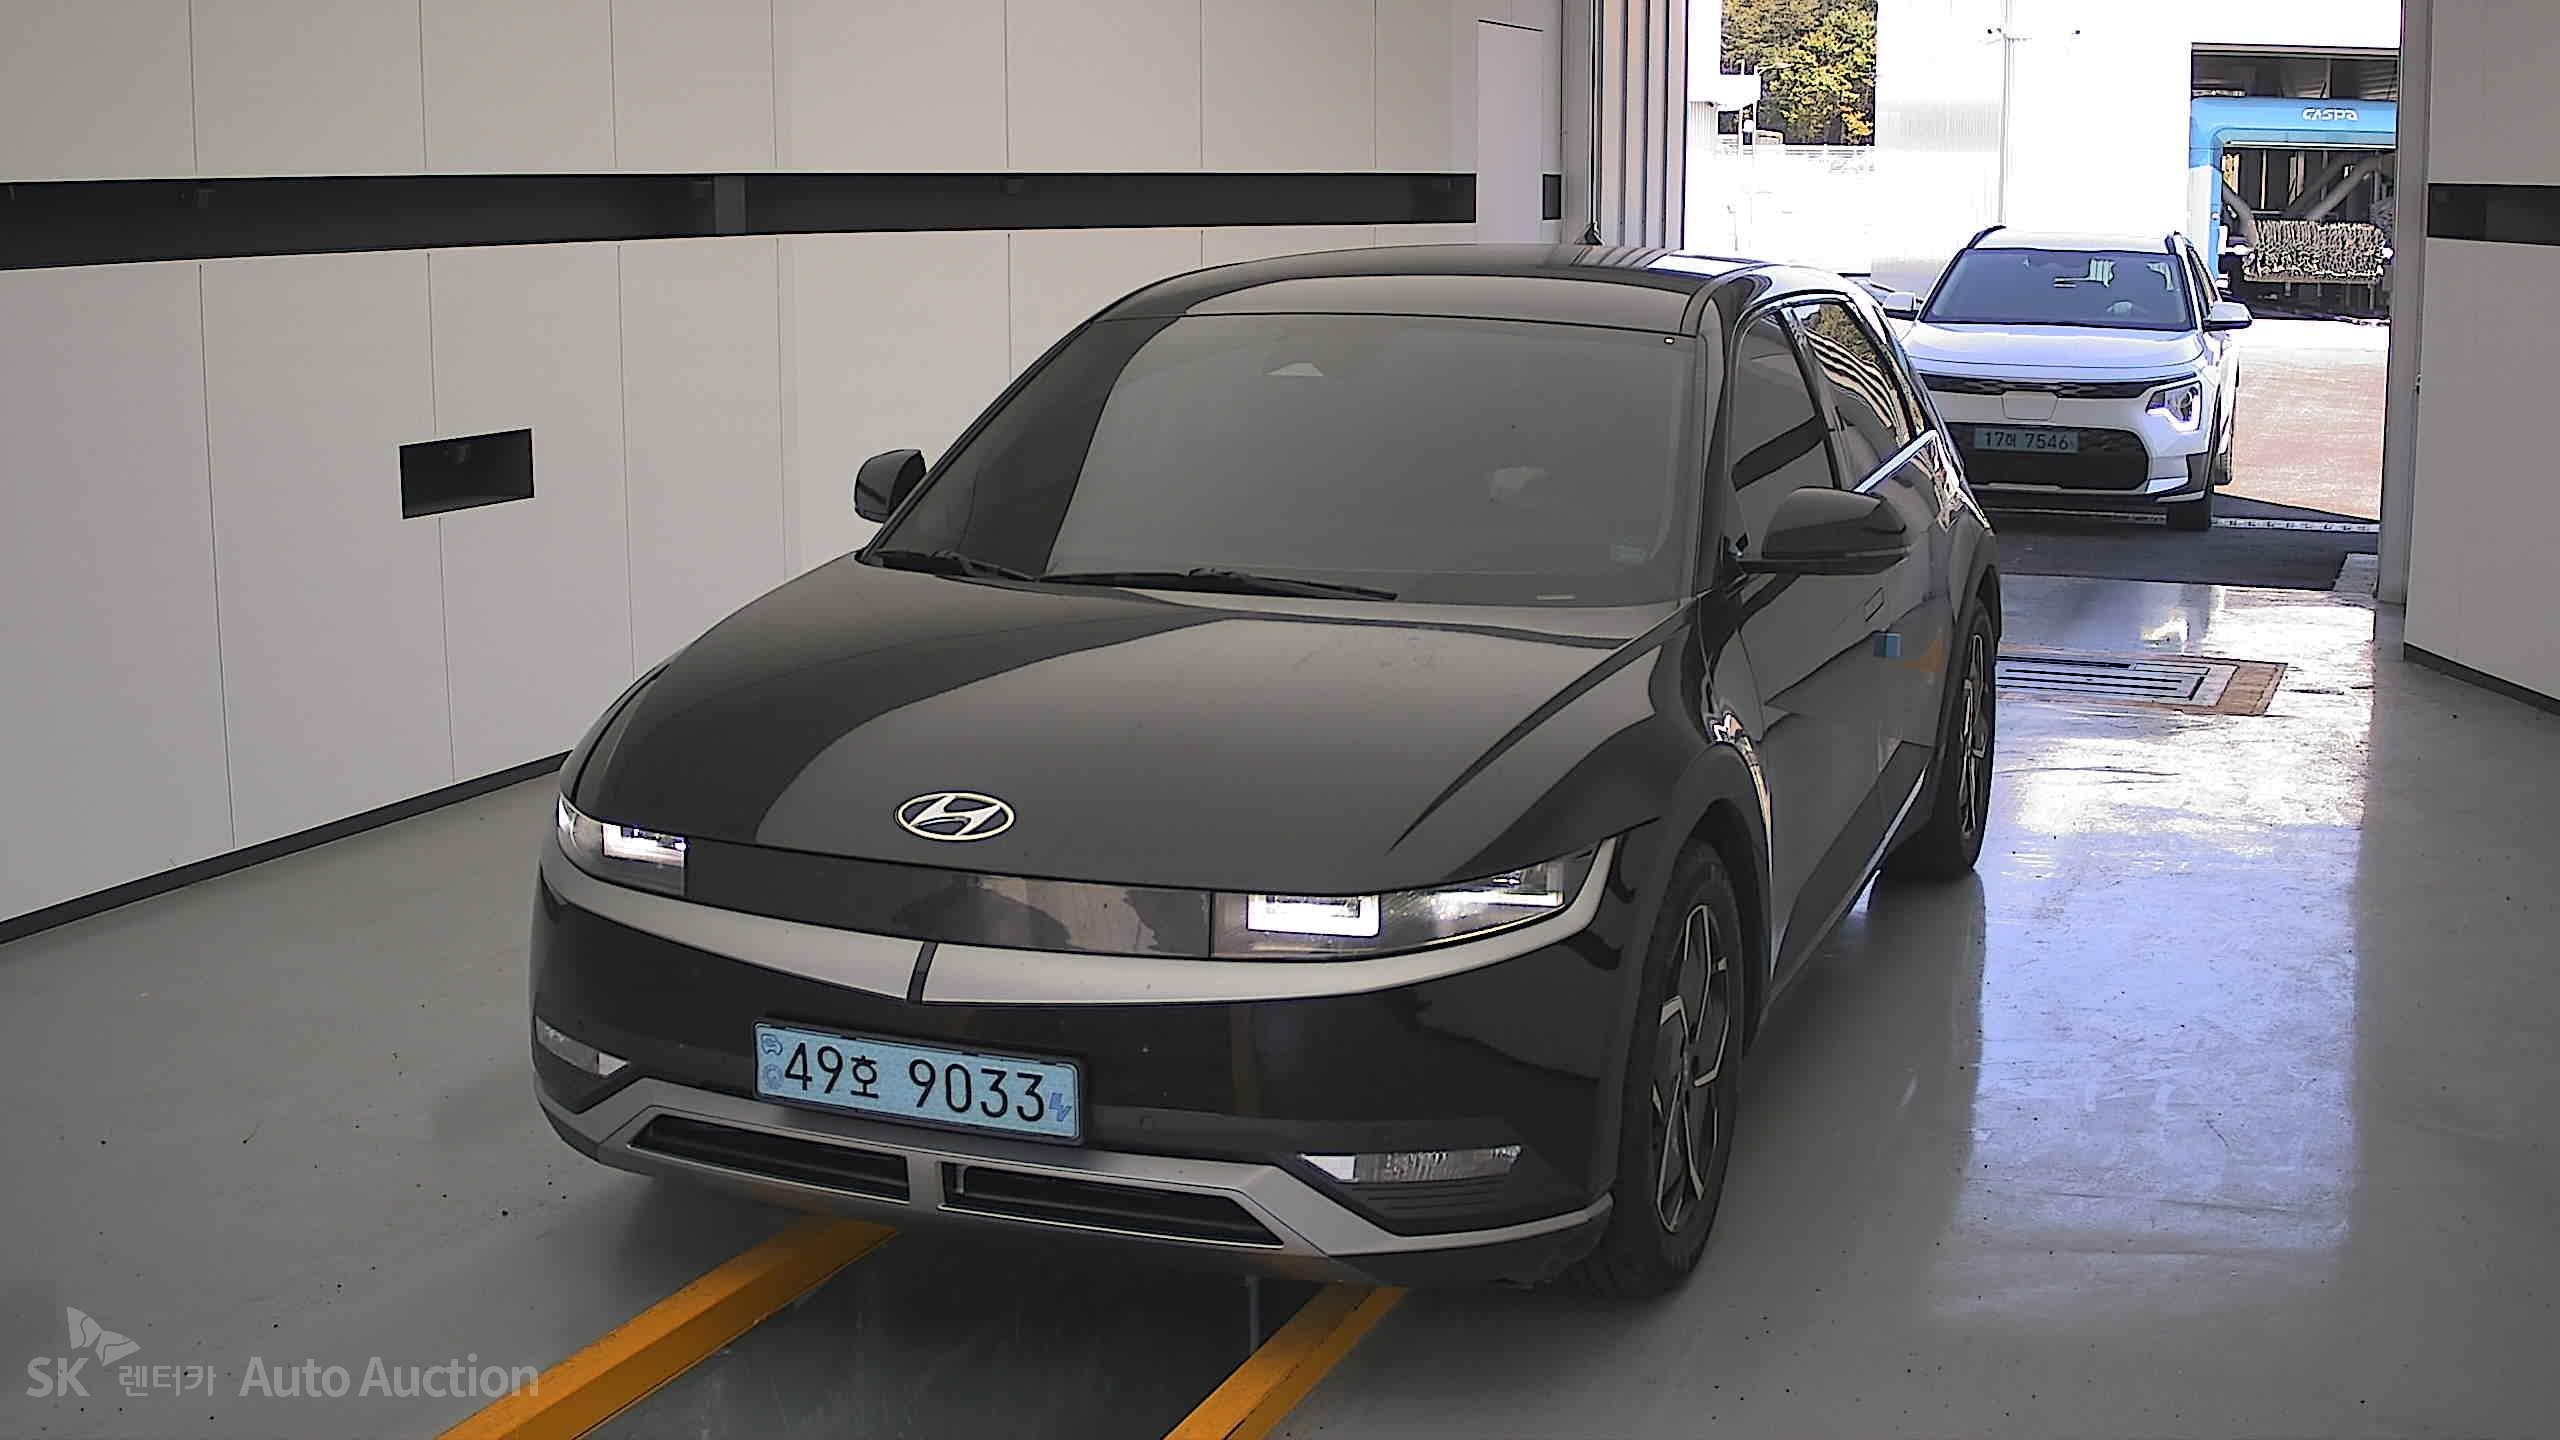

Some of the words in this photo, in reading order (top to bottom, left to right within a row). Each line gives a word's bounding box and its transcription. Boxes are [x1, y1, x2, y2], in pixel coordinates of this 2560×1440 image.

[2024, 432, 2069, 450] 7546
[784, 1042, 879, 1099] 49호
[908, 1058, 1045, 1122] 9033
